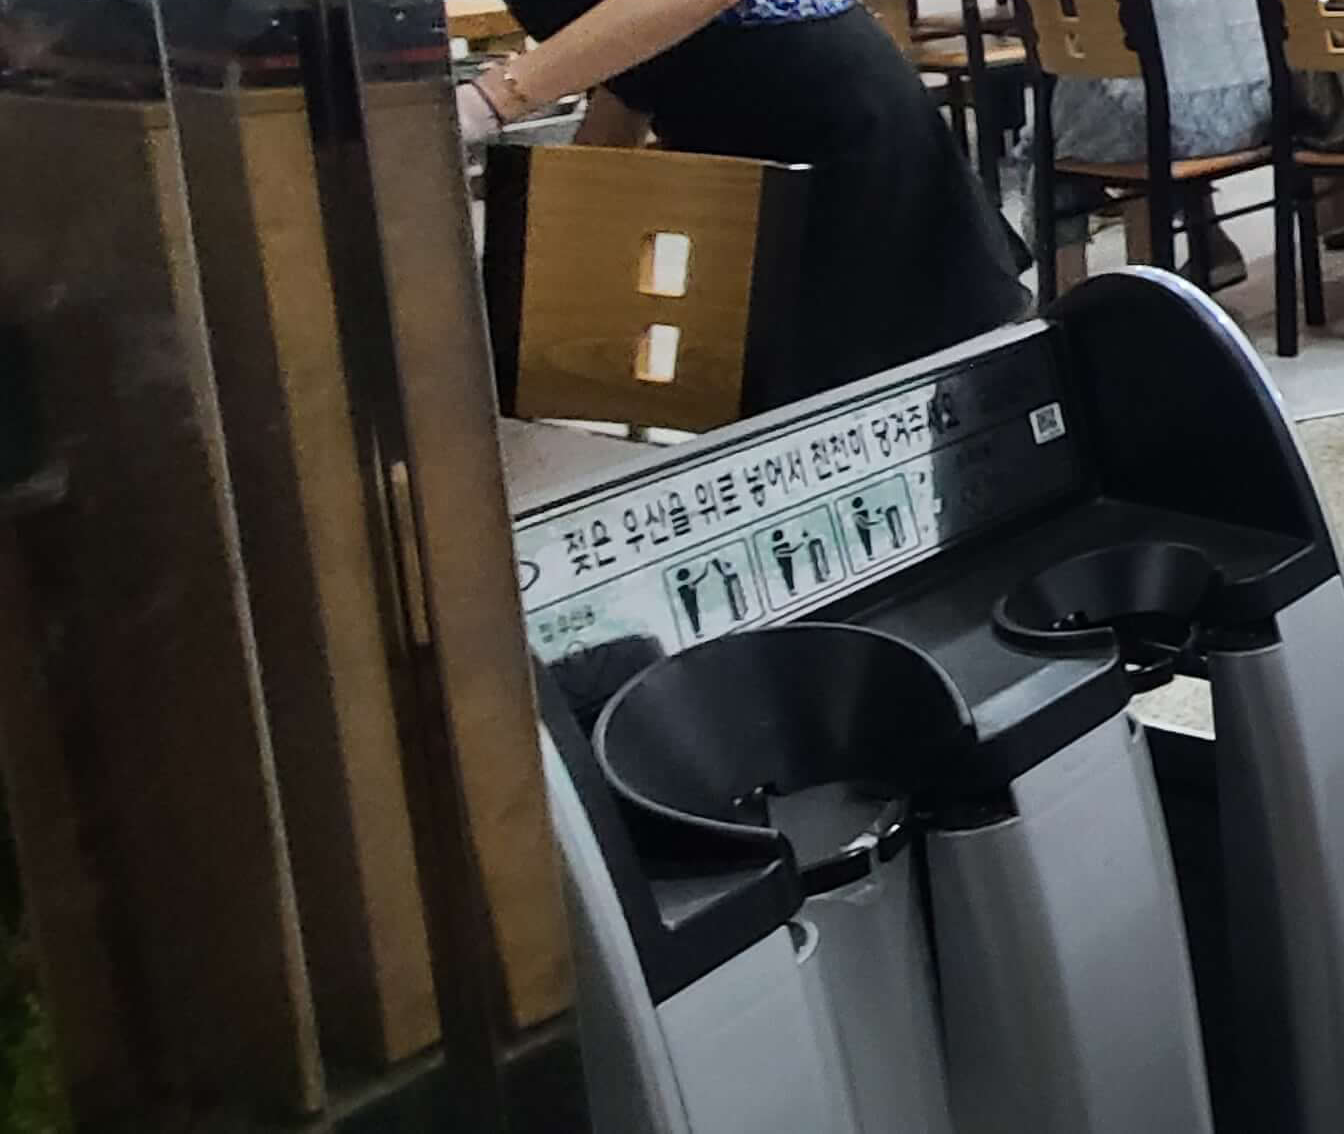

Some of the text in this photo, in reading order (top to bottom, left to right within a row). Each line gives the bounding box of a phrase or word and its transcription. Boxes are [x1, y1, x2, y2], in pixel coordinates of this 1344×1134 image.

[562, 519, 616, 577] 젖은
[623, 491, 693, 547] 우산을
[694, 472, 743, 524] 위로
[743, 448, 809, 509] 넣어서
